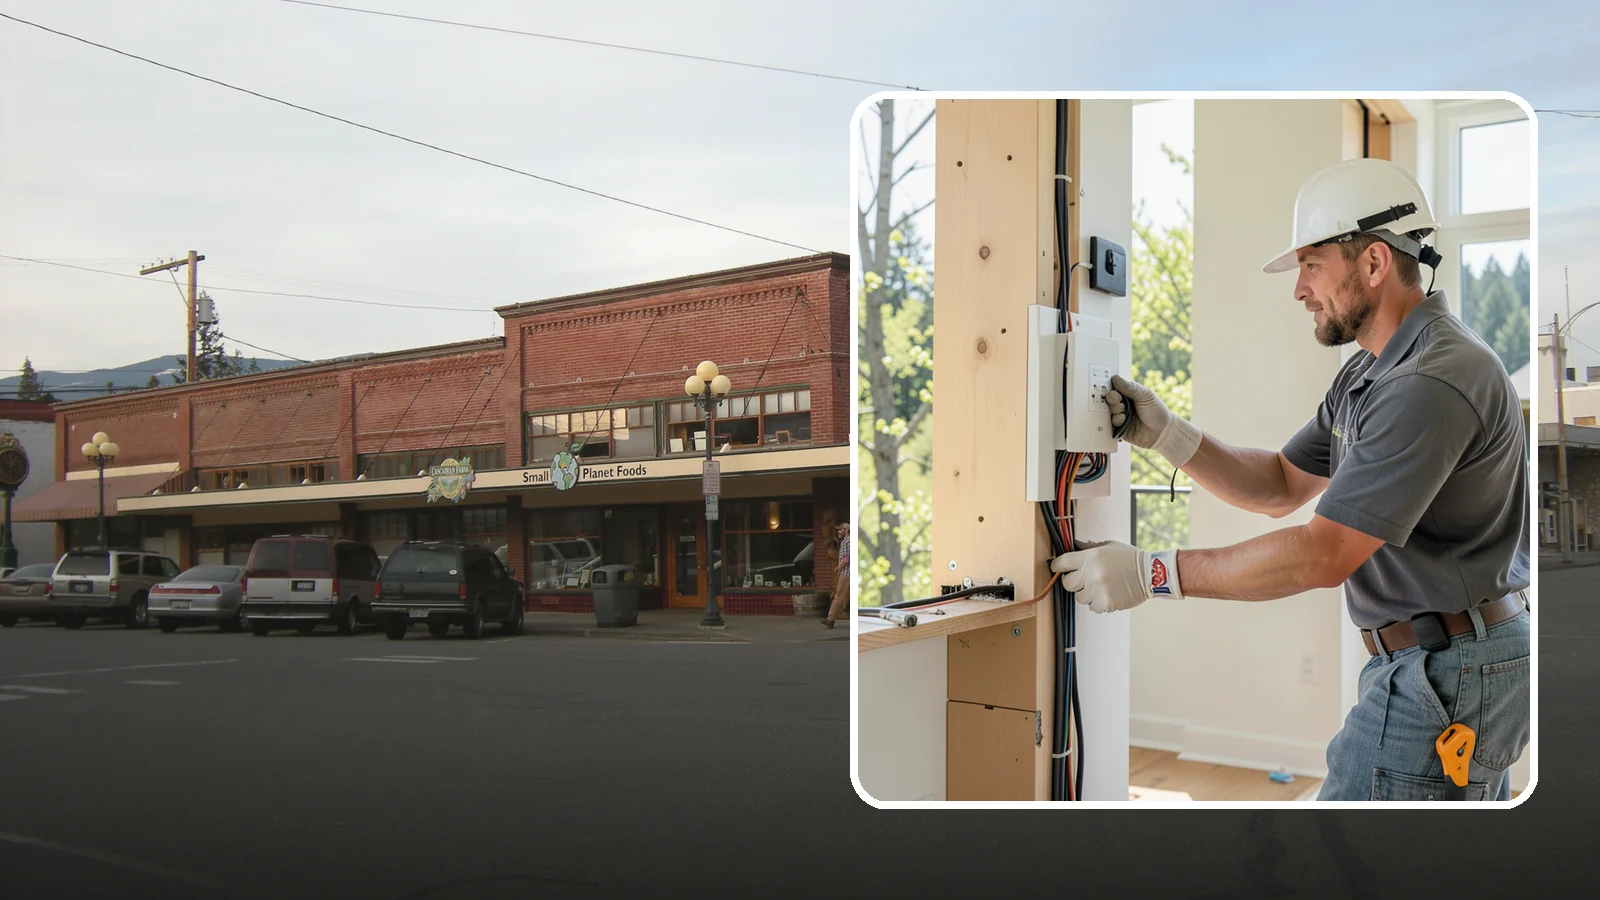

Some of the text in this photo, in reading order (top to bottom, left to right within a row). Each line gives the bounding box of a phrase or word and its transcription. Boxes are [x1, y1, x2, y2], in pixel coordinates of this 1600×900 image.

[523, 464, 647, 483] Small Planet Foods
